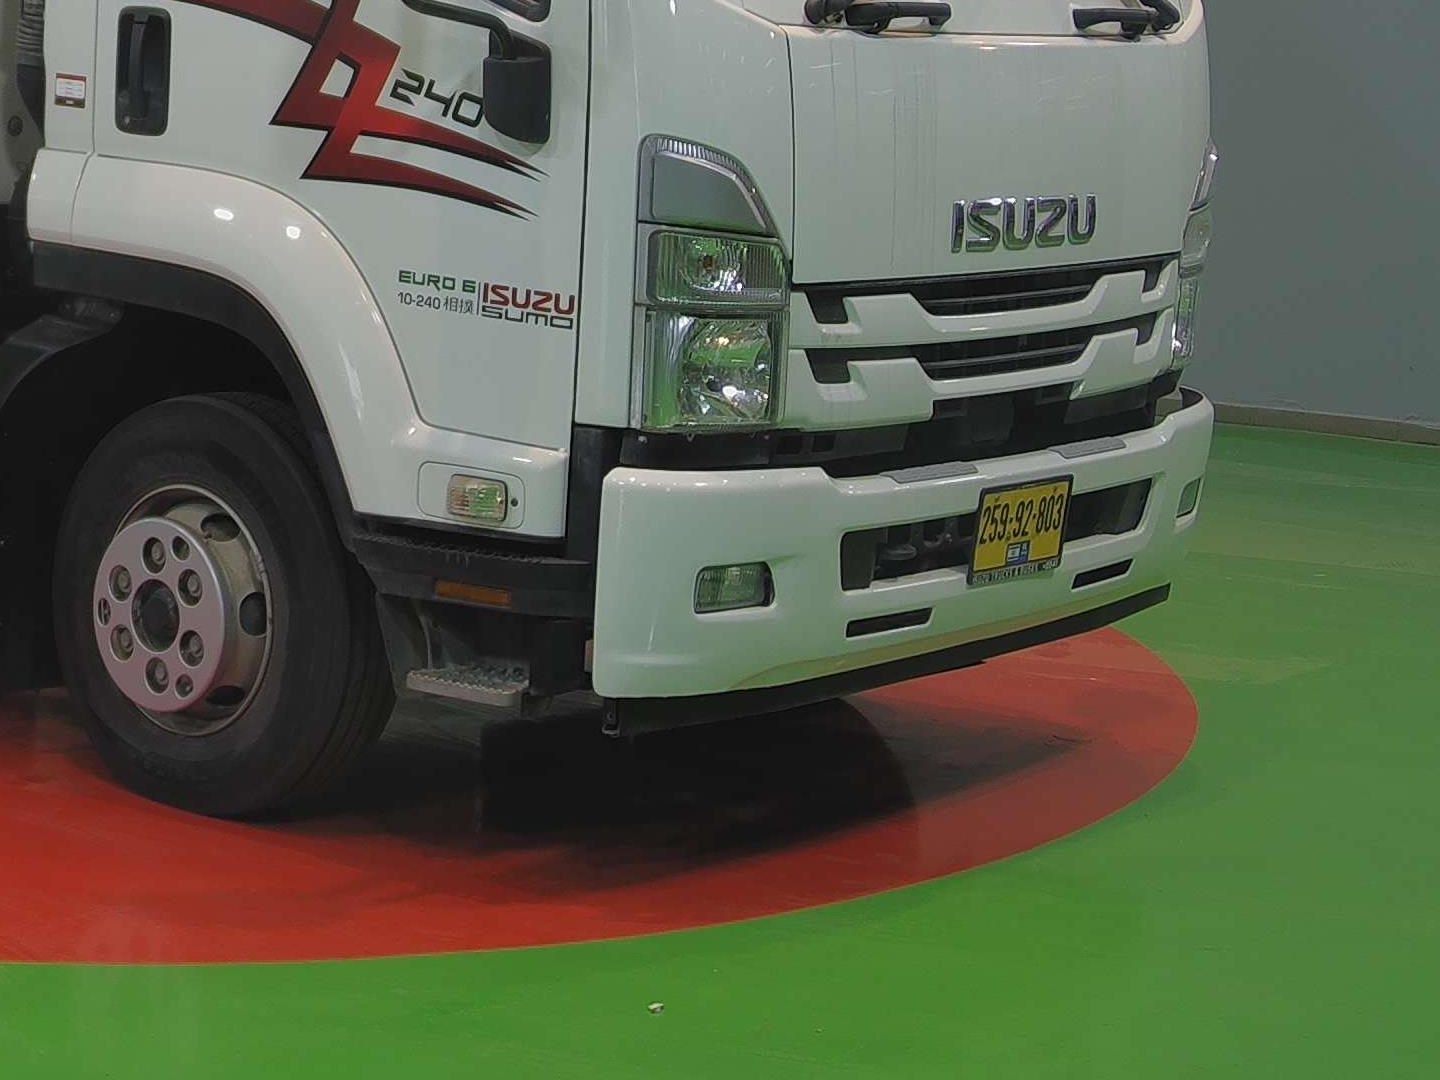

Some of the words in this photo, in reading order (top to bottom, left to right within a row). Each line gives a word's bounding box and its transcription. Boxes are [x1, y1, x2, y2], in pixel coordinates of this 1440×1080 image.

[389, 68, 485, 128] 240
[951, 193, 1096, 253] ISUZU
[398, 270, 456, 291] EURO
[462, 280, 477, 293] 6
[397, 291, 441, 309] 10-240
[482, 282, 576, 315] ISUZU
[481, 304, 574, 330] SUMO
